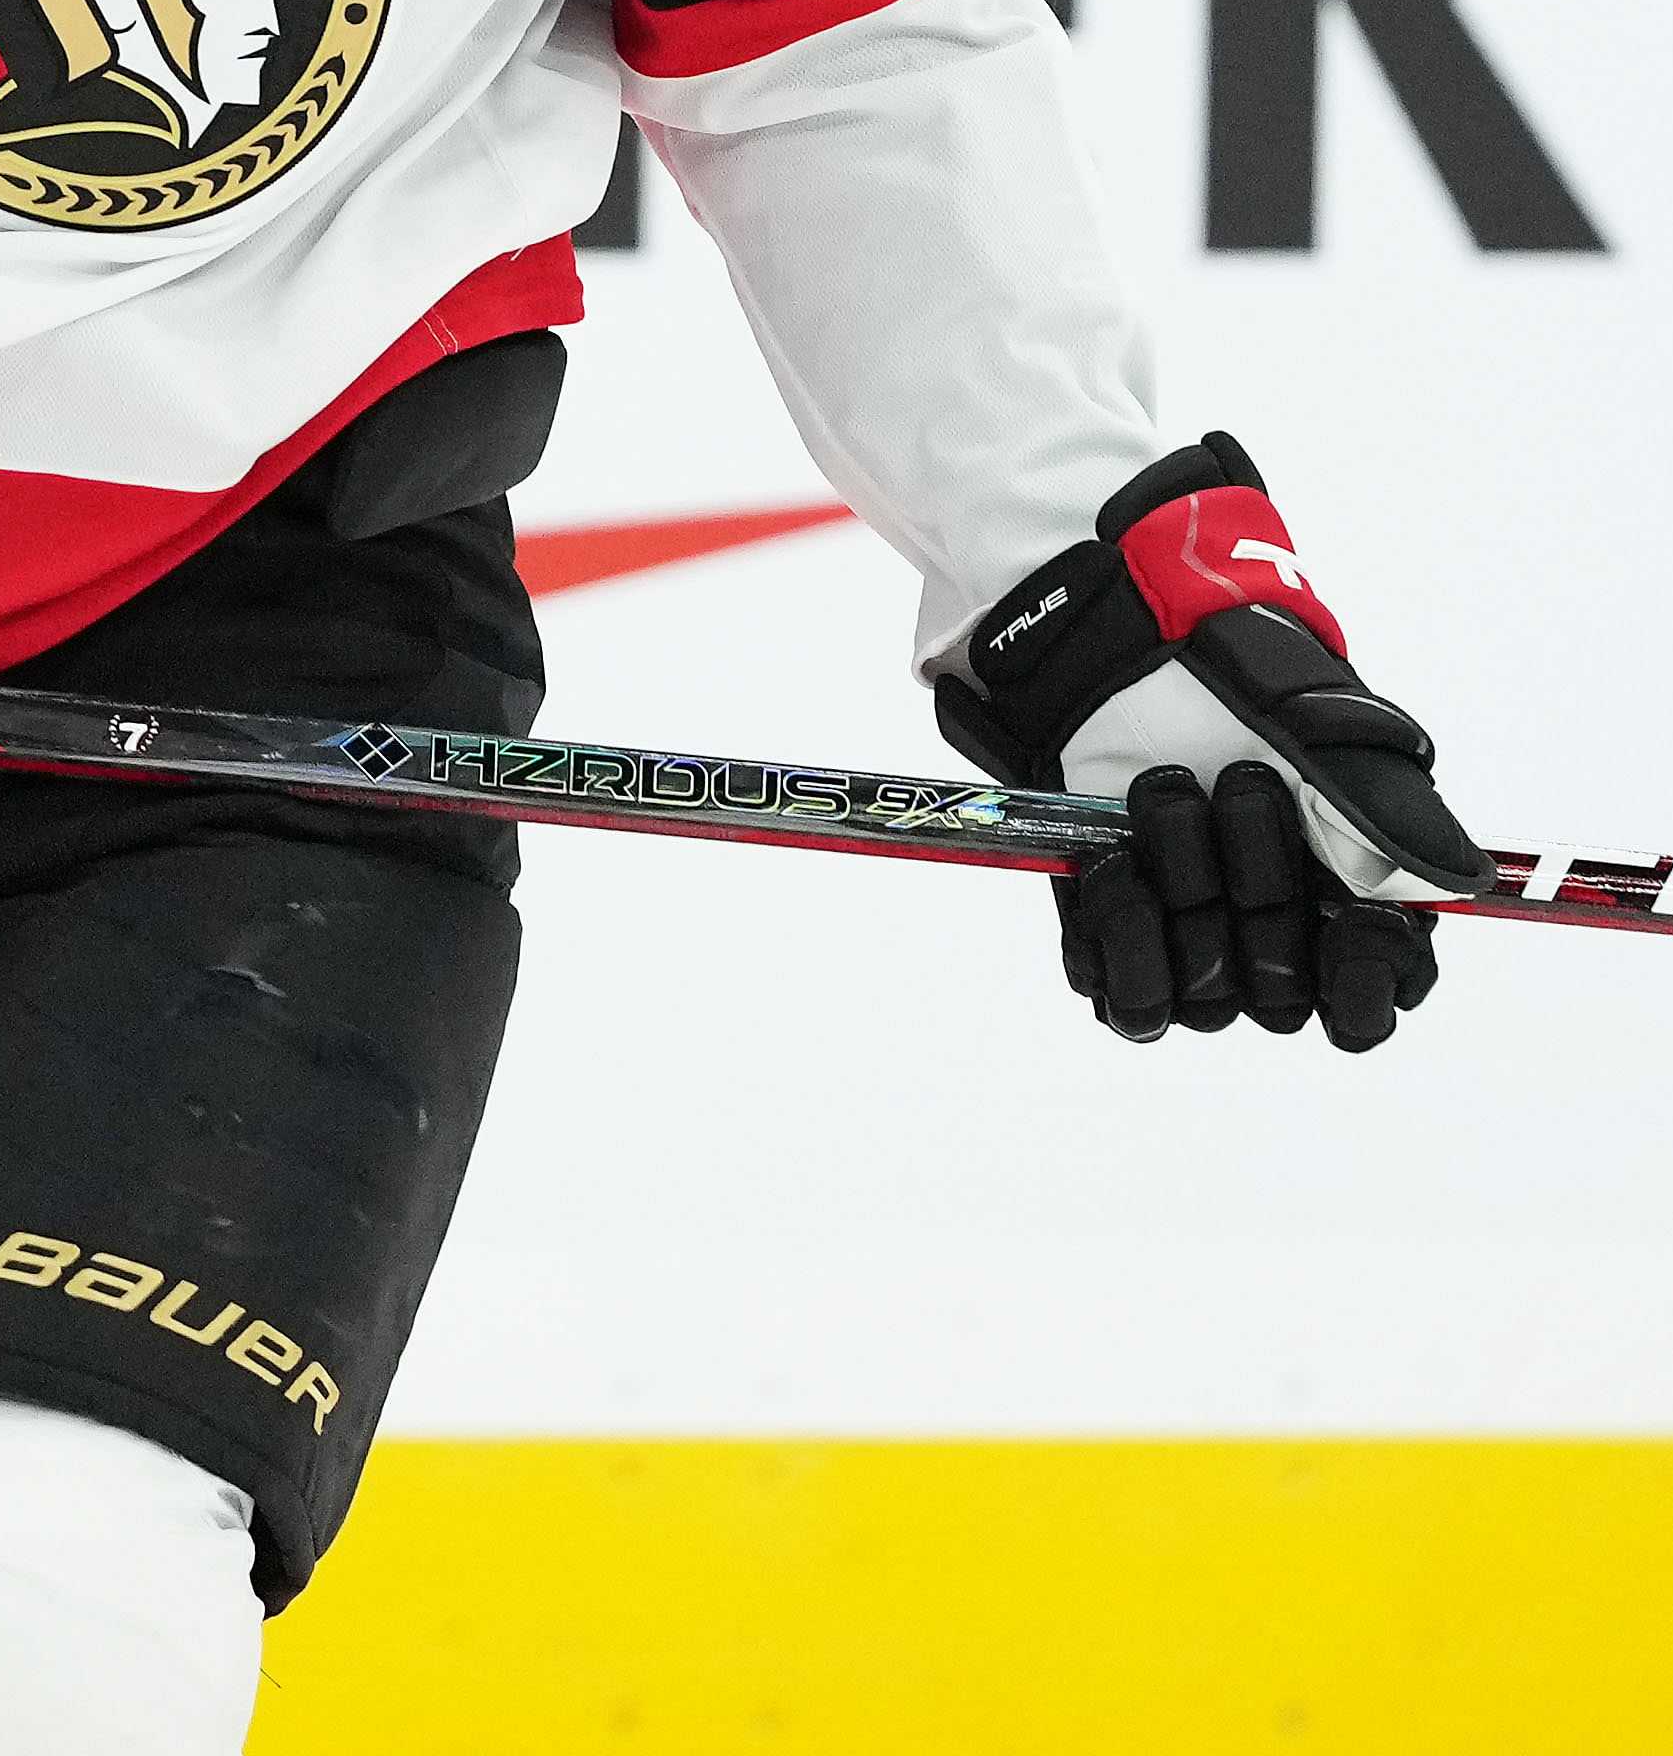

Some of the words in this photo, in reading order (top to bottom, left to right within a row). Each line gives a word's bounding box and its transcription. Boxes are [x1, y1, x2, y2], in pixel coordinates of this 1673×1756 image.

[989, 585, 1069, 652] TRUE
[118, 721, 149, 753] 7
[430, 733, 851, 822] HZRDUS
